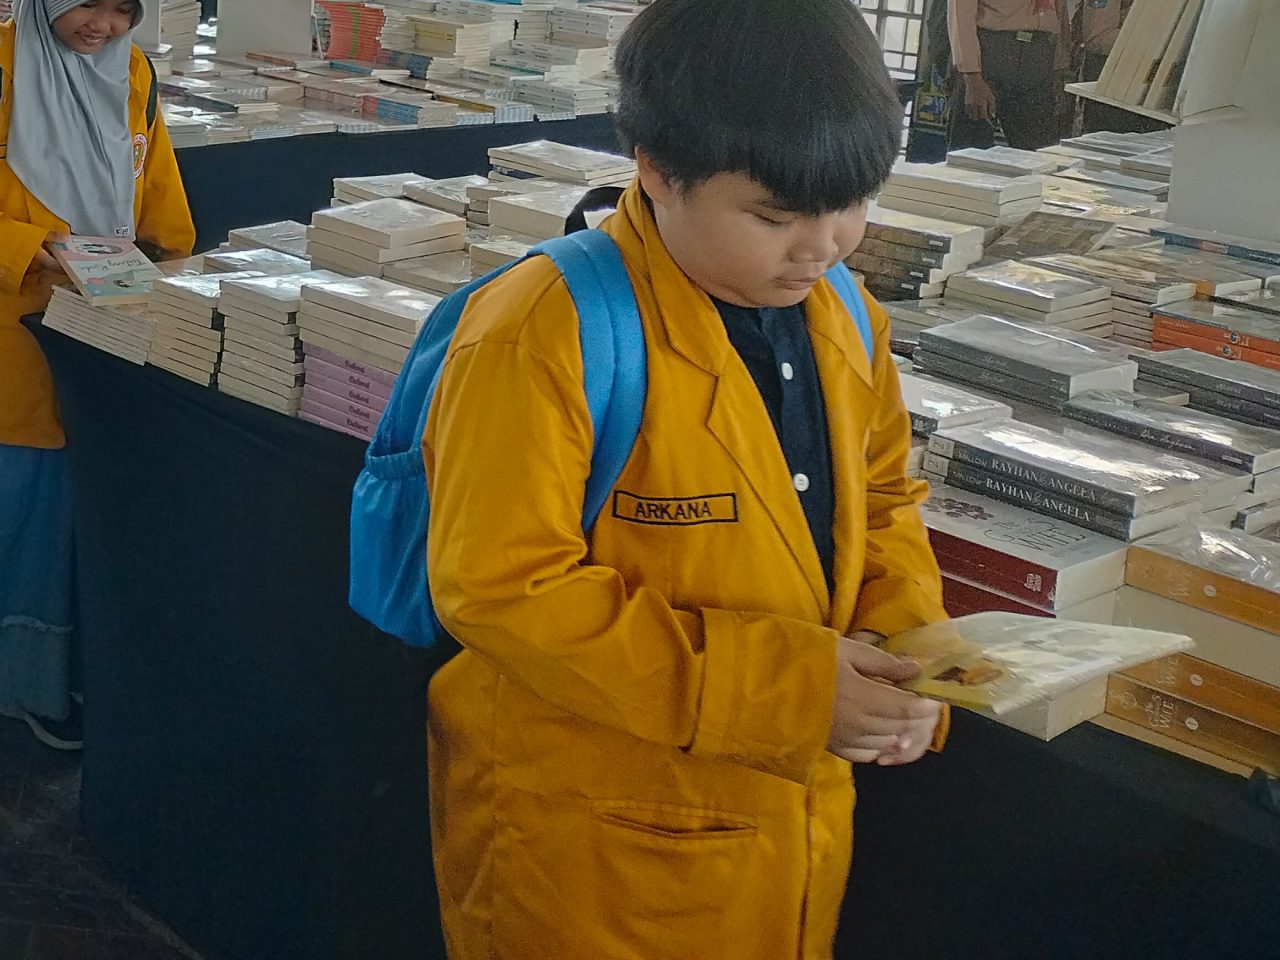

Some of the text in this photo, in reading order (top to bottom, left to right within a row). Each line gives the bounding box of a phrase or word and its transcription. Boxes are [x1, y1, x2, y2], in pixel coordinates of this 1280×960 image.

[986, 477, 1033, 503] RAYHAN
[1043, 497, 1091, 522] ANGELA
[991, 459, 1039, 483] RAYHAN
[1048, 478, 1096, 502] ANGELA
[635, 501, 713, 520] ARKANA
